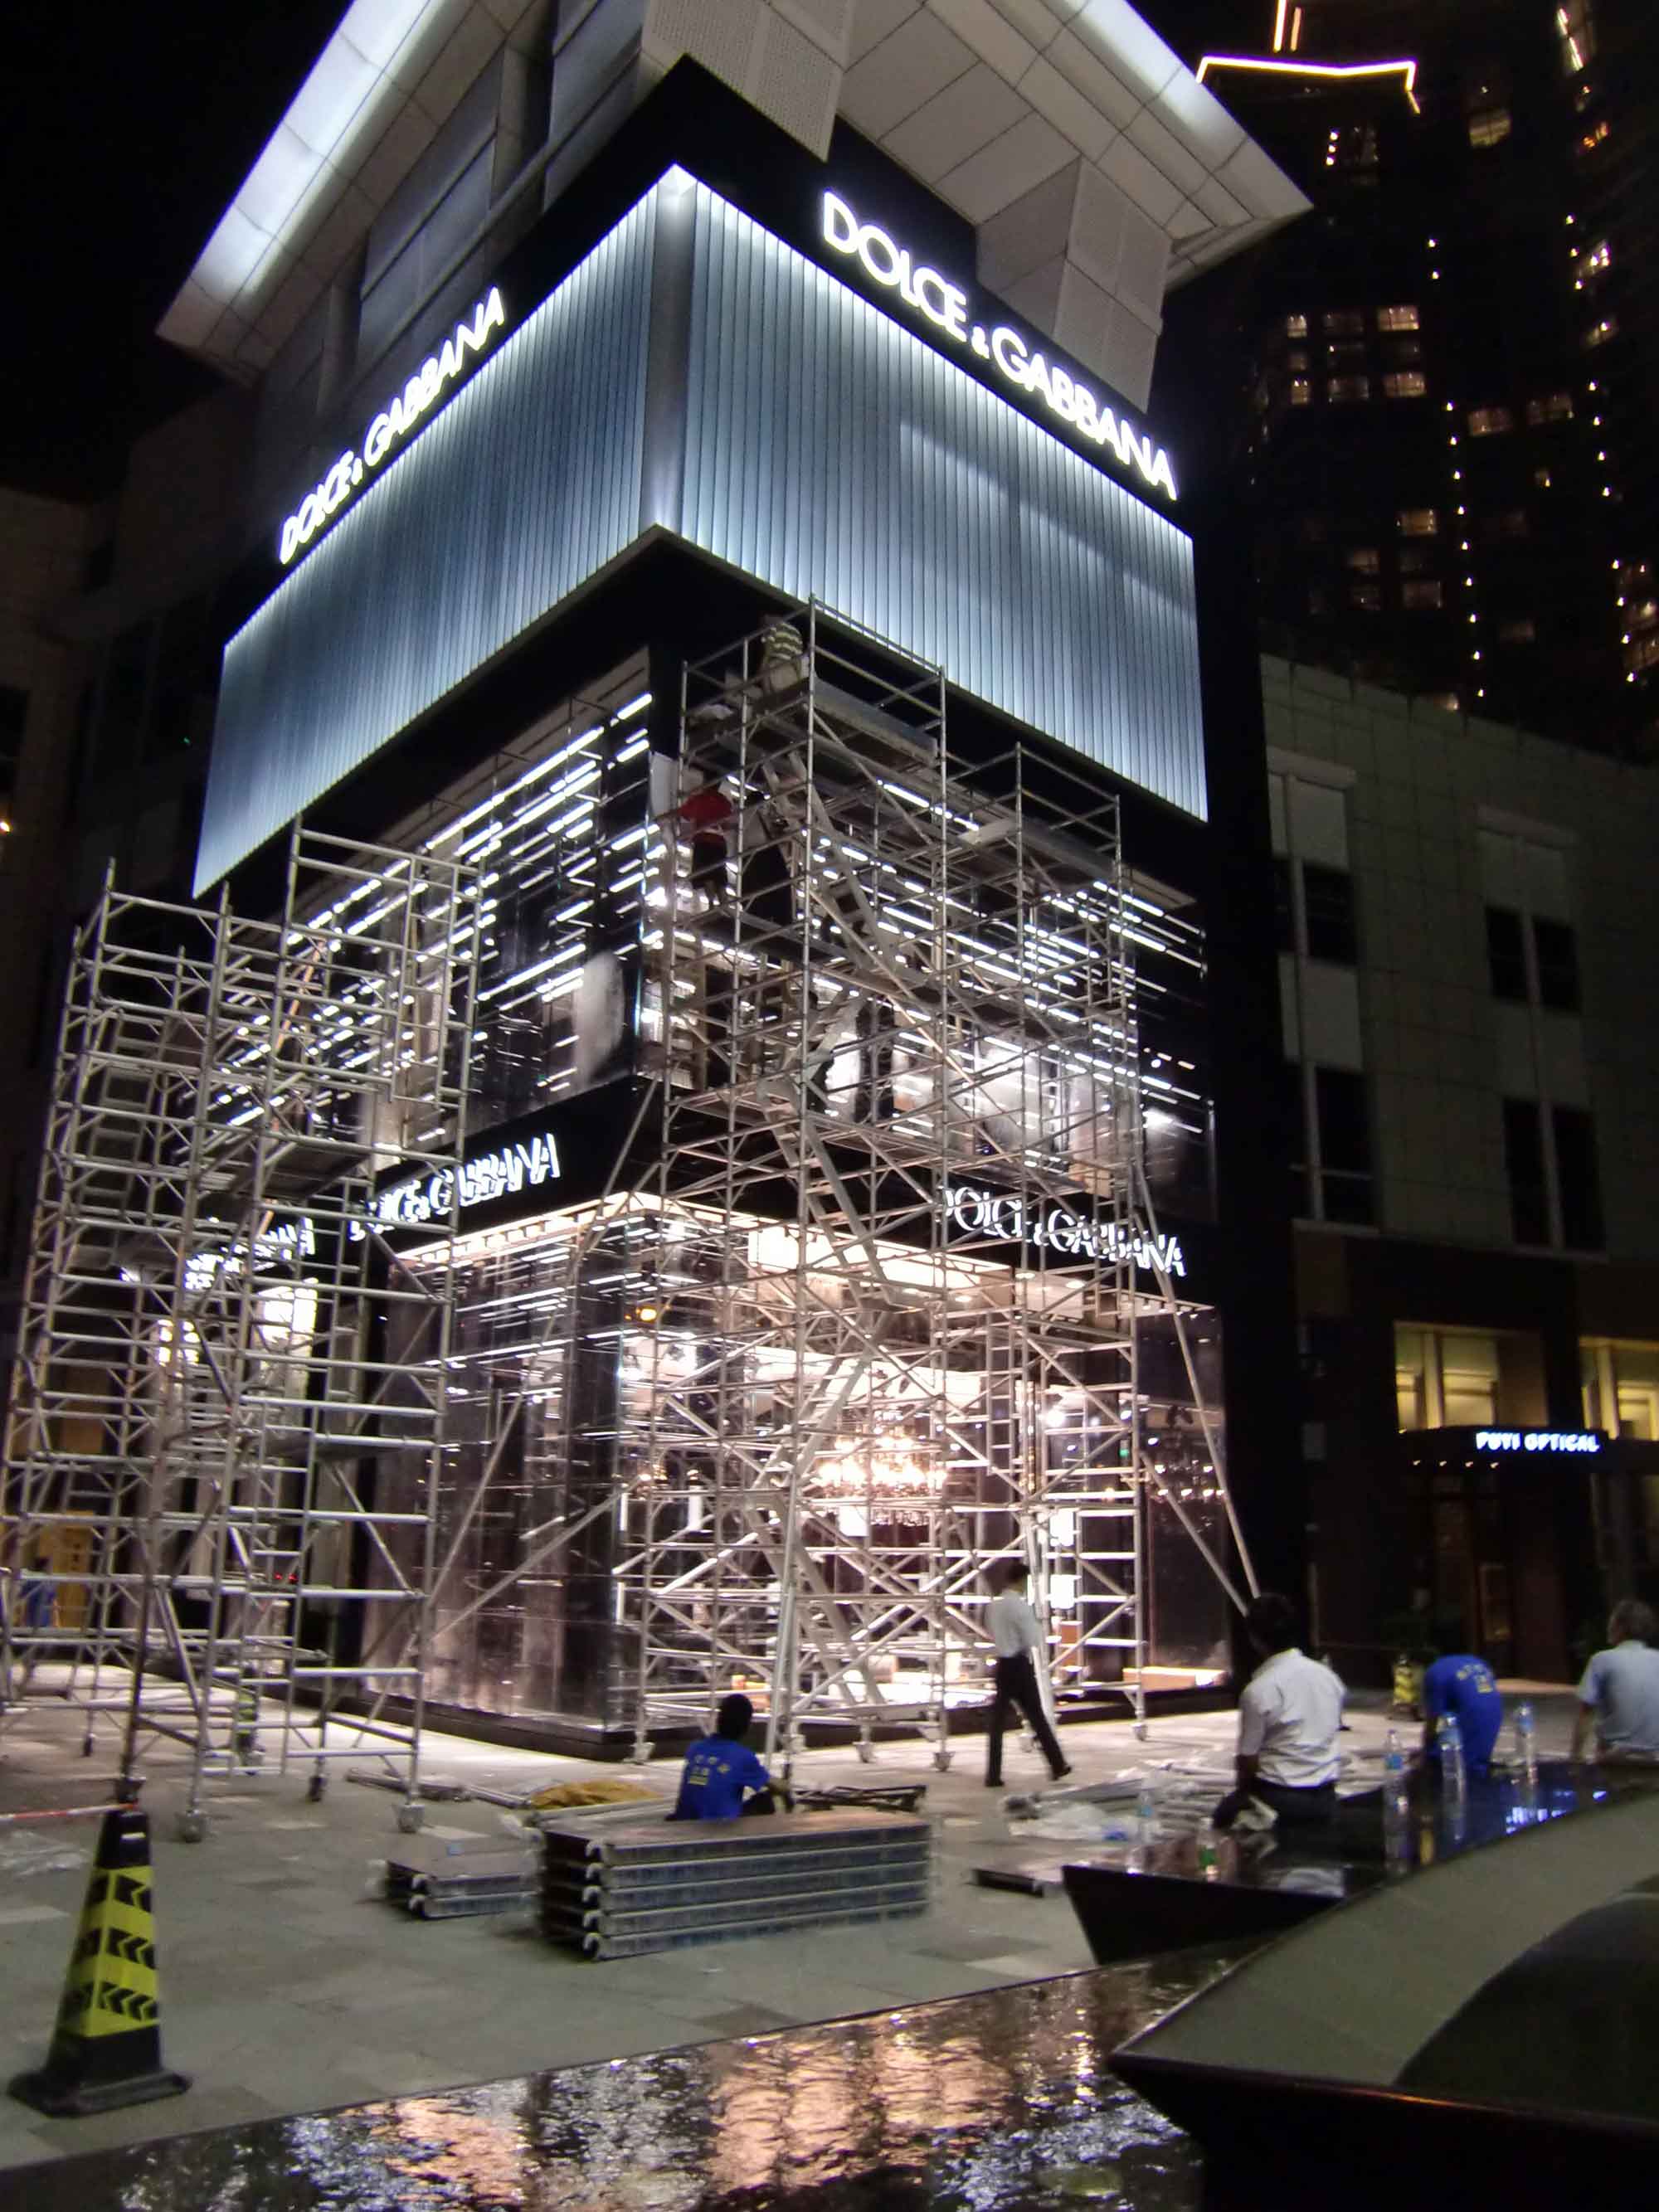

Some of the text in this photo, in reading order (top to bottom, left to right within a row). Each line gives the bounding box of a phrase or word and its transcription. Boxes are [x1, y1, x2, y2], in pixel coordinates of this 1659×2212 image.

[364, 287, 505, 466] GABBANA
[824, 192, 1177, 500] DOLCE & GABBANA
[1524, 1433, 1599, 1451] OPTICAL
